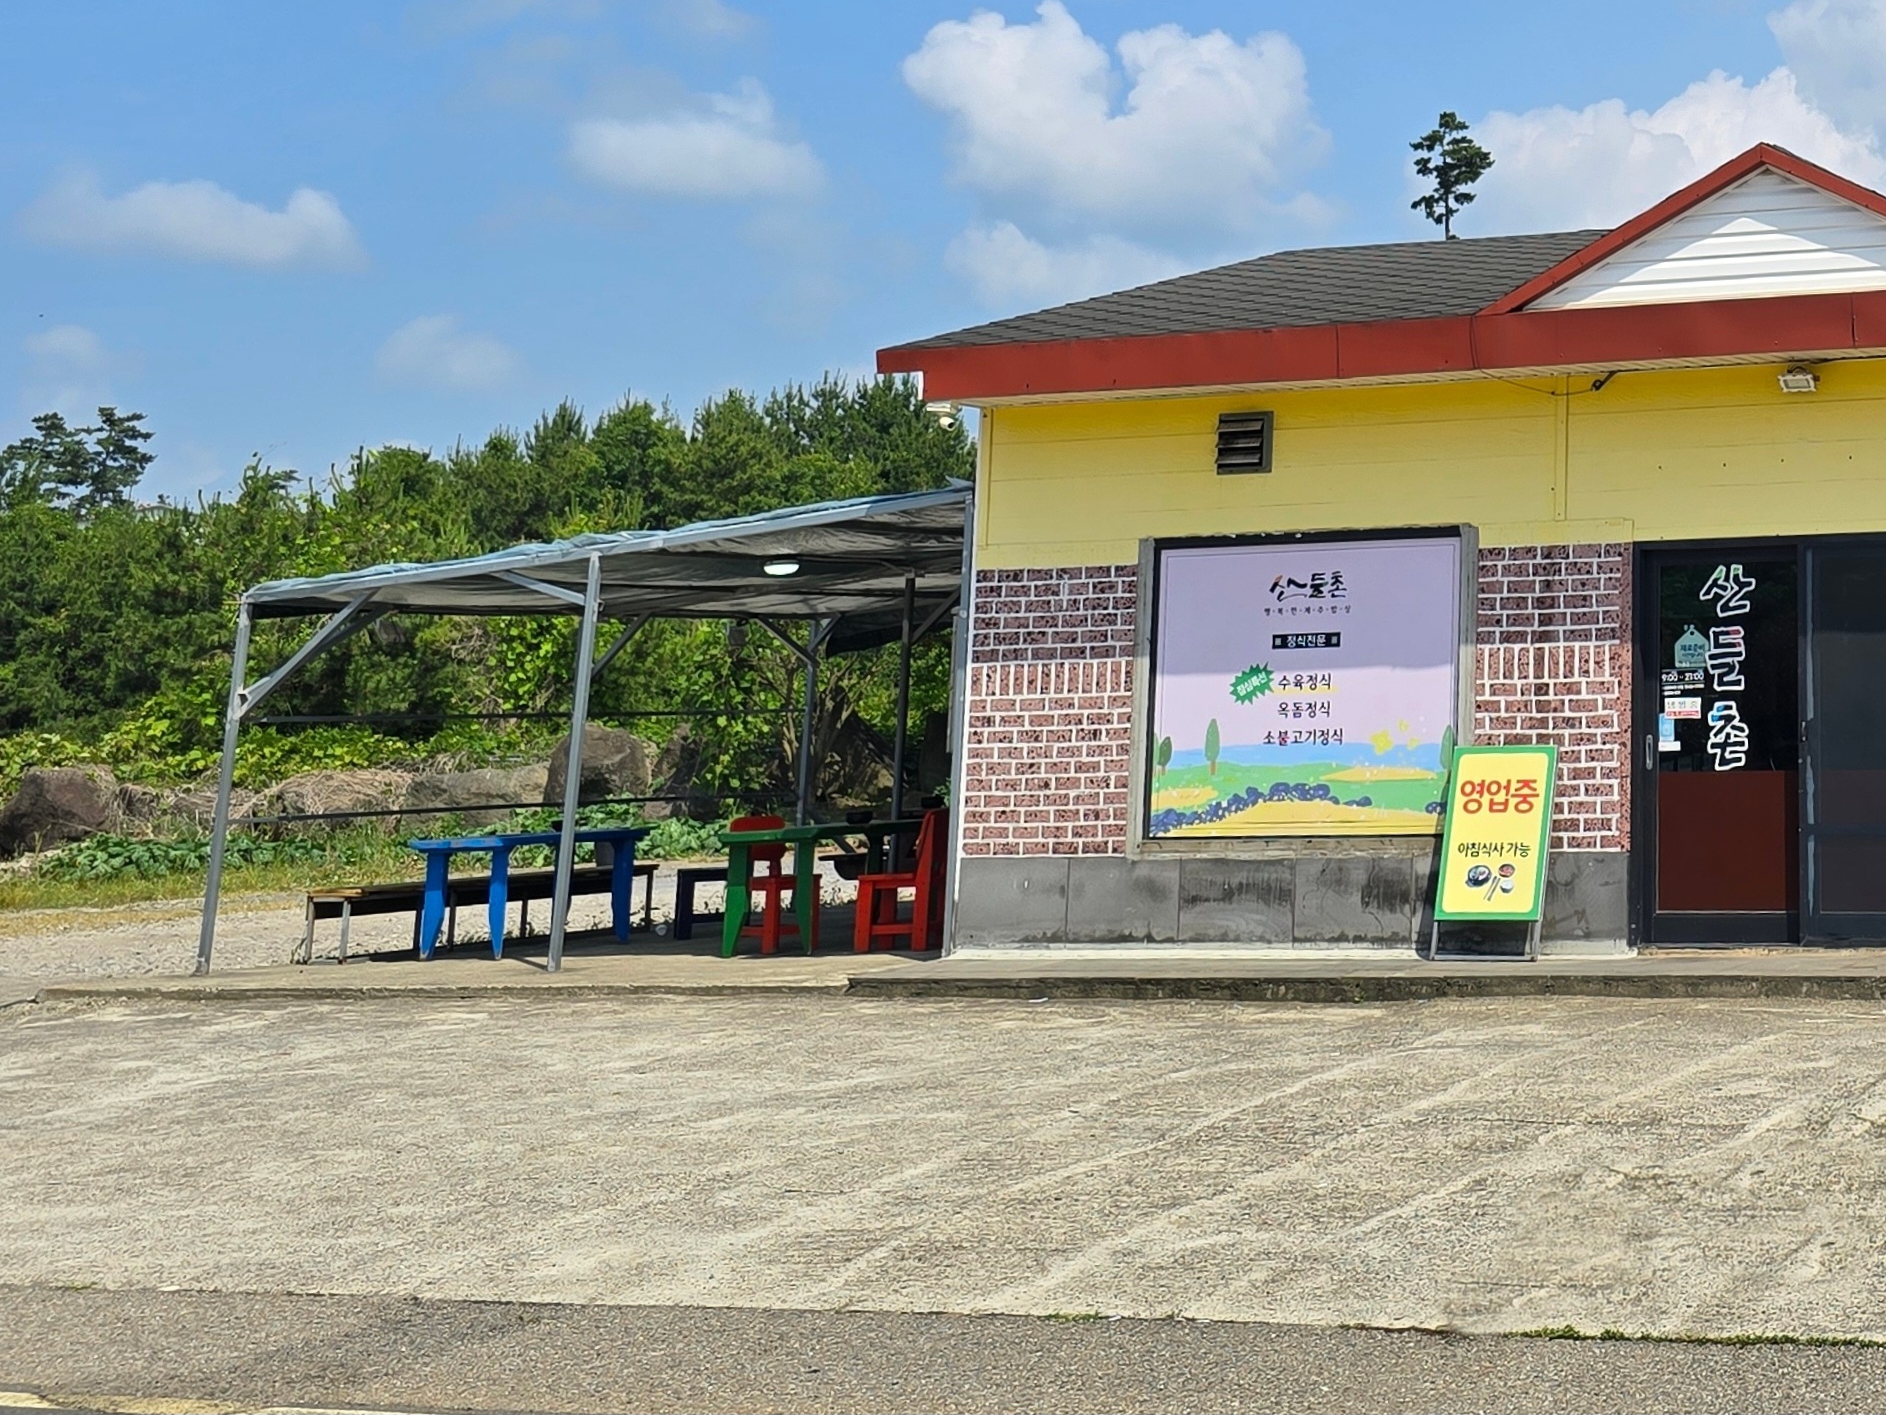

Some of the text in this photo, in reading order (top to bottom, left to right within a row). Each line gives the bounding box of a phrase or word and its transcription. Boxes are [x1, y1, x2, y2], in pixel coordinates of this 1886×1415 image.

[1269, 570, 1347, 603] 산들촌
[1287, 634, 1326, 648] 정식전문
[1700, 564, 1756, 772] 산들촌
[1278, 673, 1332, 691] 수육정식
[1277, 701, 1331, 719] 옥돔정식
[1263, 728, 1343, 746] 소불고기정식
[1460, 779, 1540, 815] 영업중
[1458, 843, 1532, 857] 아침식사 가능
